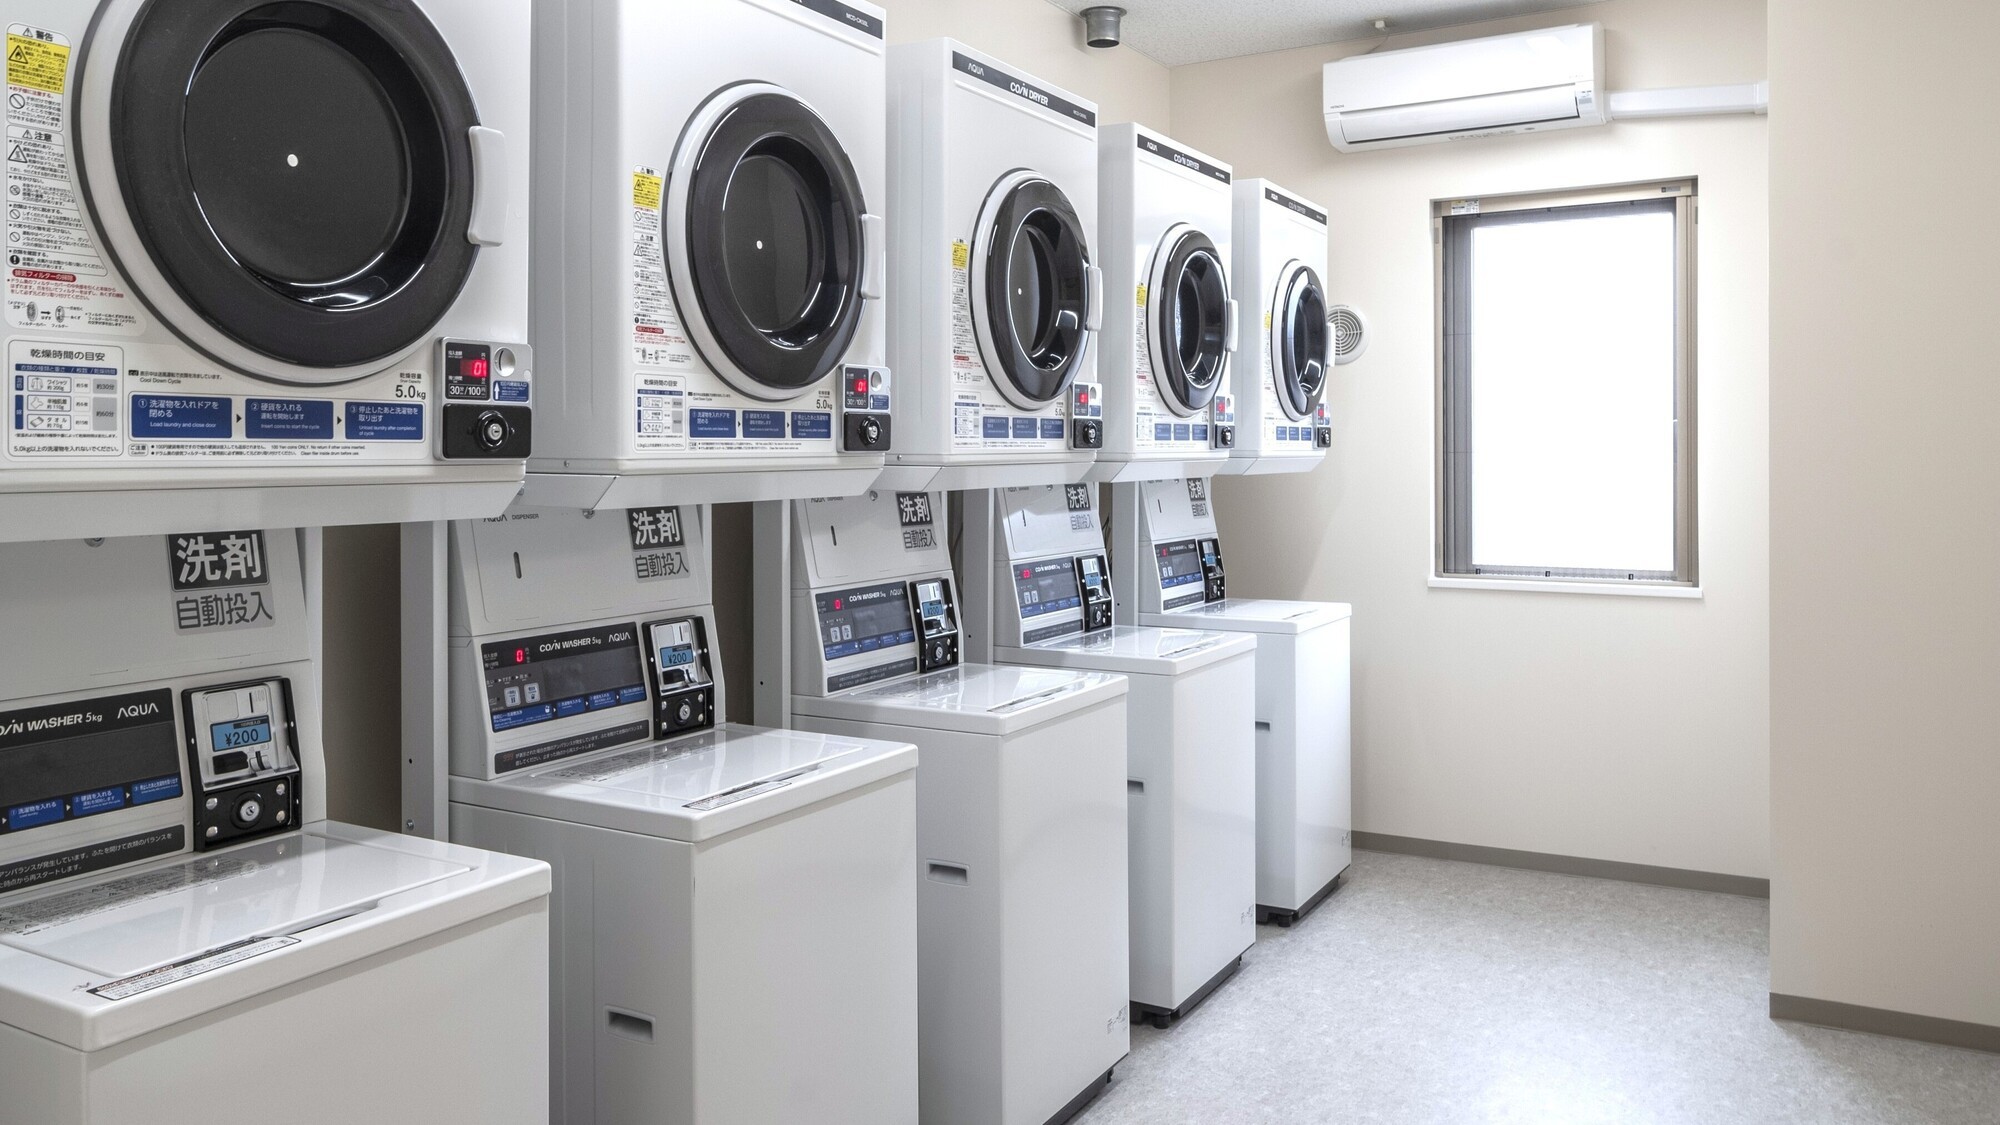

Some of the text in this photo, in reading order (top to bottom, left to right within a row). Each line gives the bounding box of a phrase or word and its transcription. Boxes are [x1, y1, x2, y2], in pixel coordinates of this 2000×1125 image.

[36, 30, 53, 42] 警告
[968, 62, 984, 76] AQUA
[1010, 82, 1048, 106] COIN DRYER
[35, 131, 52, 142] 注意
[30, 349, 105, 361] 乾燥時間の目安
[395, 384, 426, 399] 5.0kg
[149, 400, 219, 410] 洗濯物を入れドアを
[261, 403, 302, 412] 硬貨を入れる
[359, 406, 418, 415] 停止したあと洗濯物を
[149, 410, 173, 418] 閉める
[1067, 487, 1089, 508] 洗剤
[900, 496, 930, 523] 洗剤
[632, 510, 680, 545] 洗剤
[1070, 514, 1094, 530] 自動投入
[903, 529, 937, 549] 自動投入
[176, 534, 262, 583] 洗剤
[634, 552, 689, 579] 自動投入
[862, 592, 880, 600] WASHER
[176, 592, 273, 630] 自動投入
[608, 632, 631, 643] AQUA
[540, 639, 561, 652] COIN
[562, 638, 591, 649] WASHER
[515, 649, 524, 663] 0
[668, 652, 687, 664] ¥200
[117, 702, 159, 719] AQUA
[27, 714, 82, 731] WASHER
[85, 712, 102, 723] 5kg
[224, 728, 258, 746] ¥200
